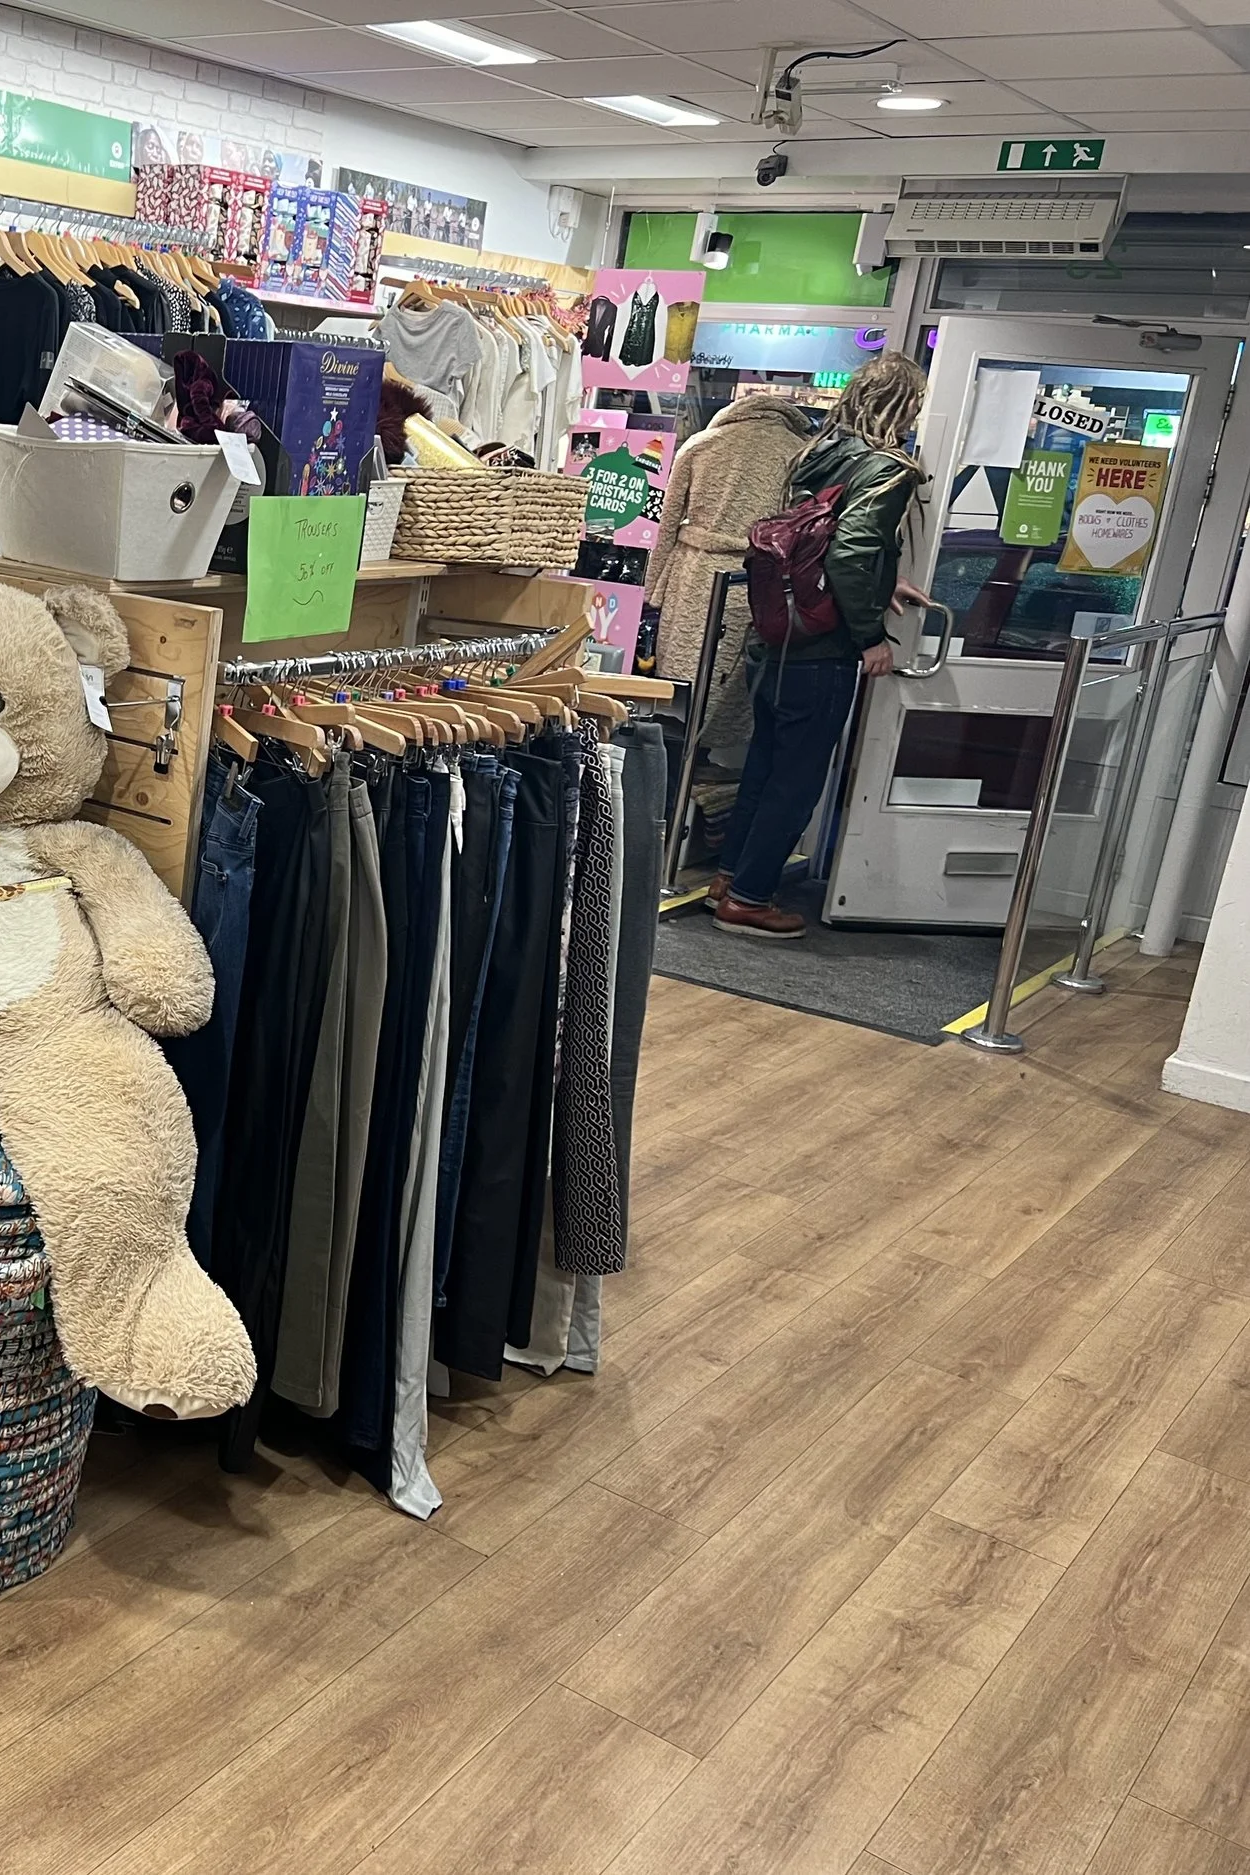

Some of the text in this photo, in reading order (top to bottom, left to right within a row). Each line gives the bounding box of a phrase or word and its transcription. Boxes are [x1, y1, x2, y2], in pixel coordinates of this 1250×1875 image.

[1033, 399, 1104, 434] LOSED
[1019, 460, 1067, 478] THANK
[1088, 456, 1162, 469] WE NEED VOLUNTEERS
[587, 467, 645, 492] 3 FOR 2 ON
[1026, 476, 1054, 493] YOU
[1095, 467, 1148, 490] HERE
[588, 481, 643, 504] HRISTMAS
[590, 495, 627, 514] CARDS
[294, 518, 339, 540] TROUSERS
[1116, 516, 1149, 529] CLOTHES
[296, 560, 335, 582] 50% OFF
